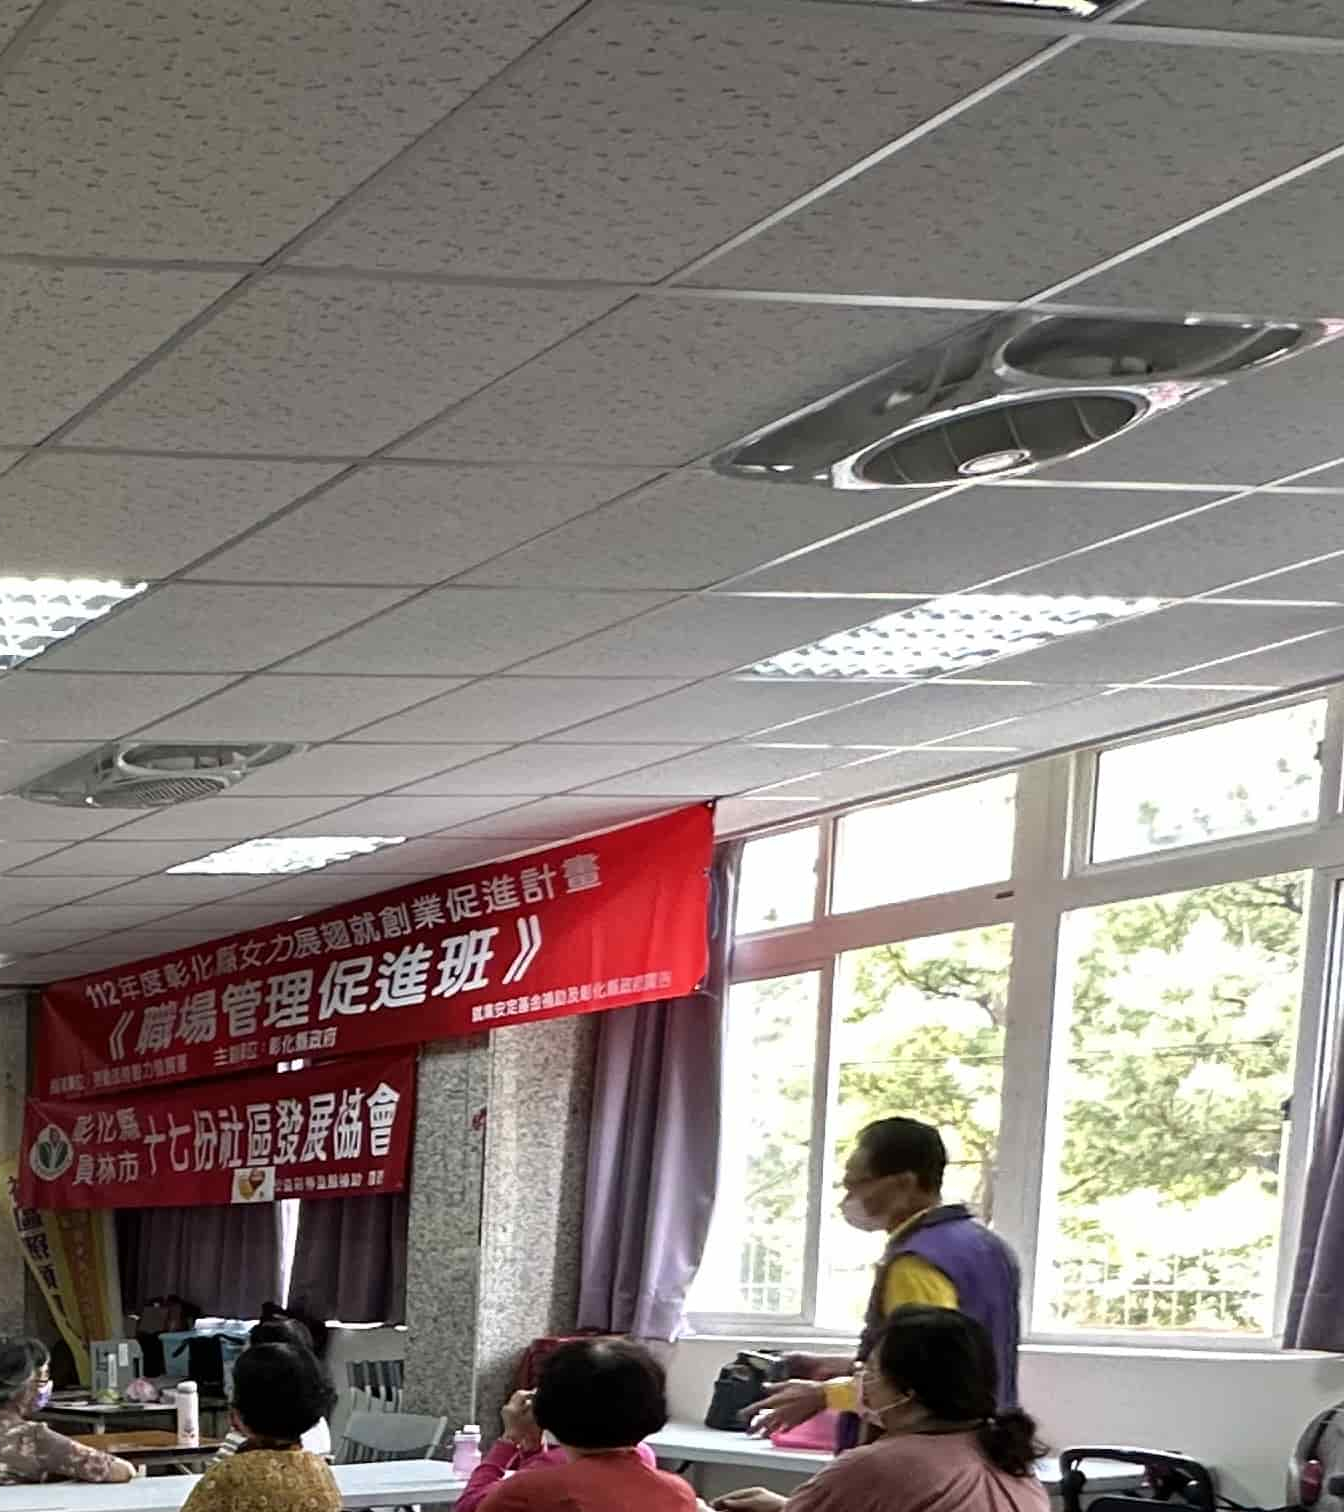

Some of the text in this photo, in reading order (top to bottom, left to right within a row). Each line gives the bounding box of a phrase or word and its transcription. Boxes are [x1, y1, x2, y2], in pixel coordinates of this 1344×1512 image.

[84, 853, 603, 1009] 112年度彰化縣女力展翅就創業促進計畫
[108, 914, 543, 1061] 《職場管理促進班》
[72, 1107, 141, 1145] 彰化縣
[72, 1151, 139, 1186] 員林市
[142, 1082, 401, 1175] 十七份社區發展協會
